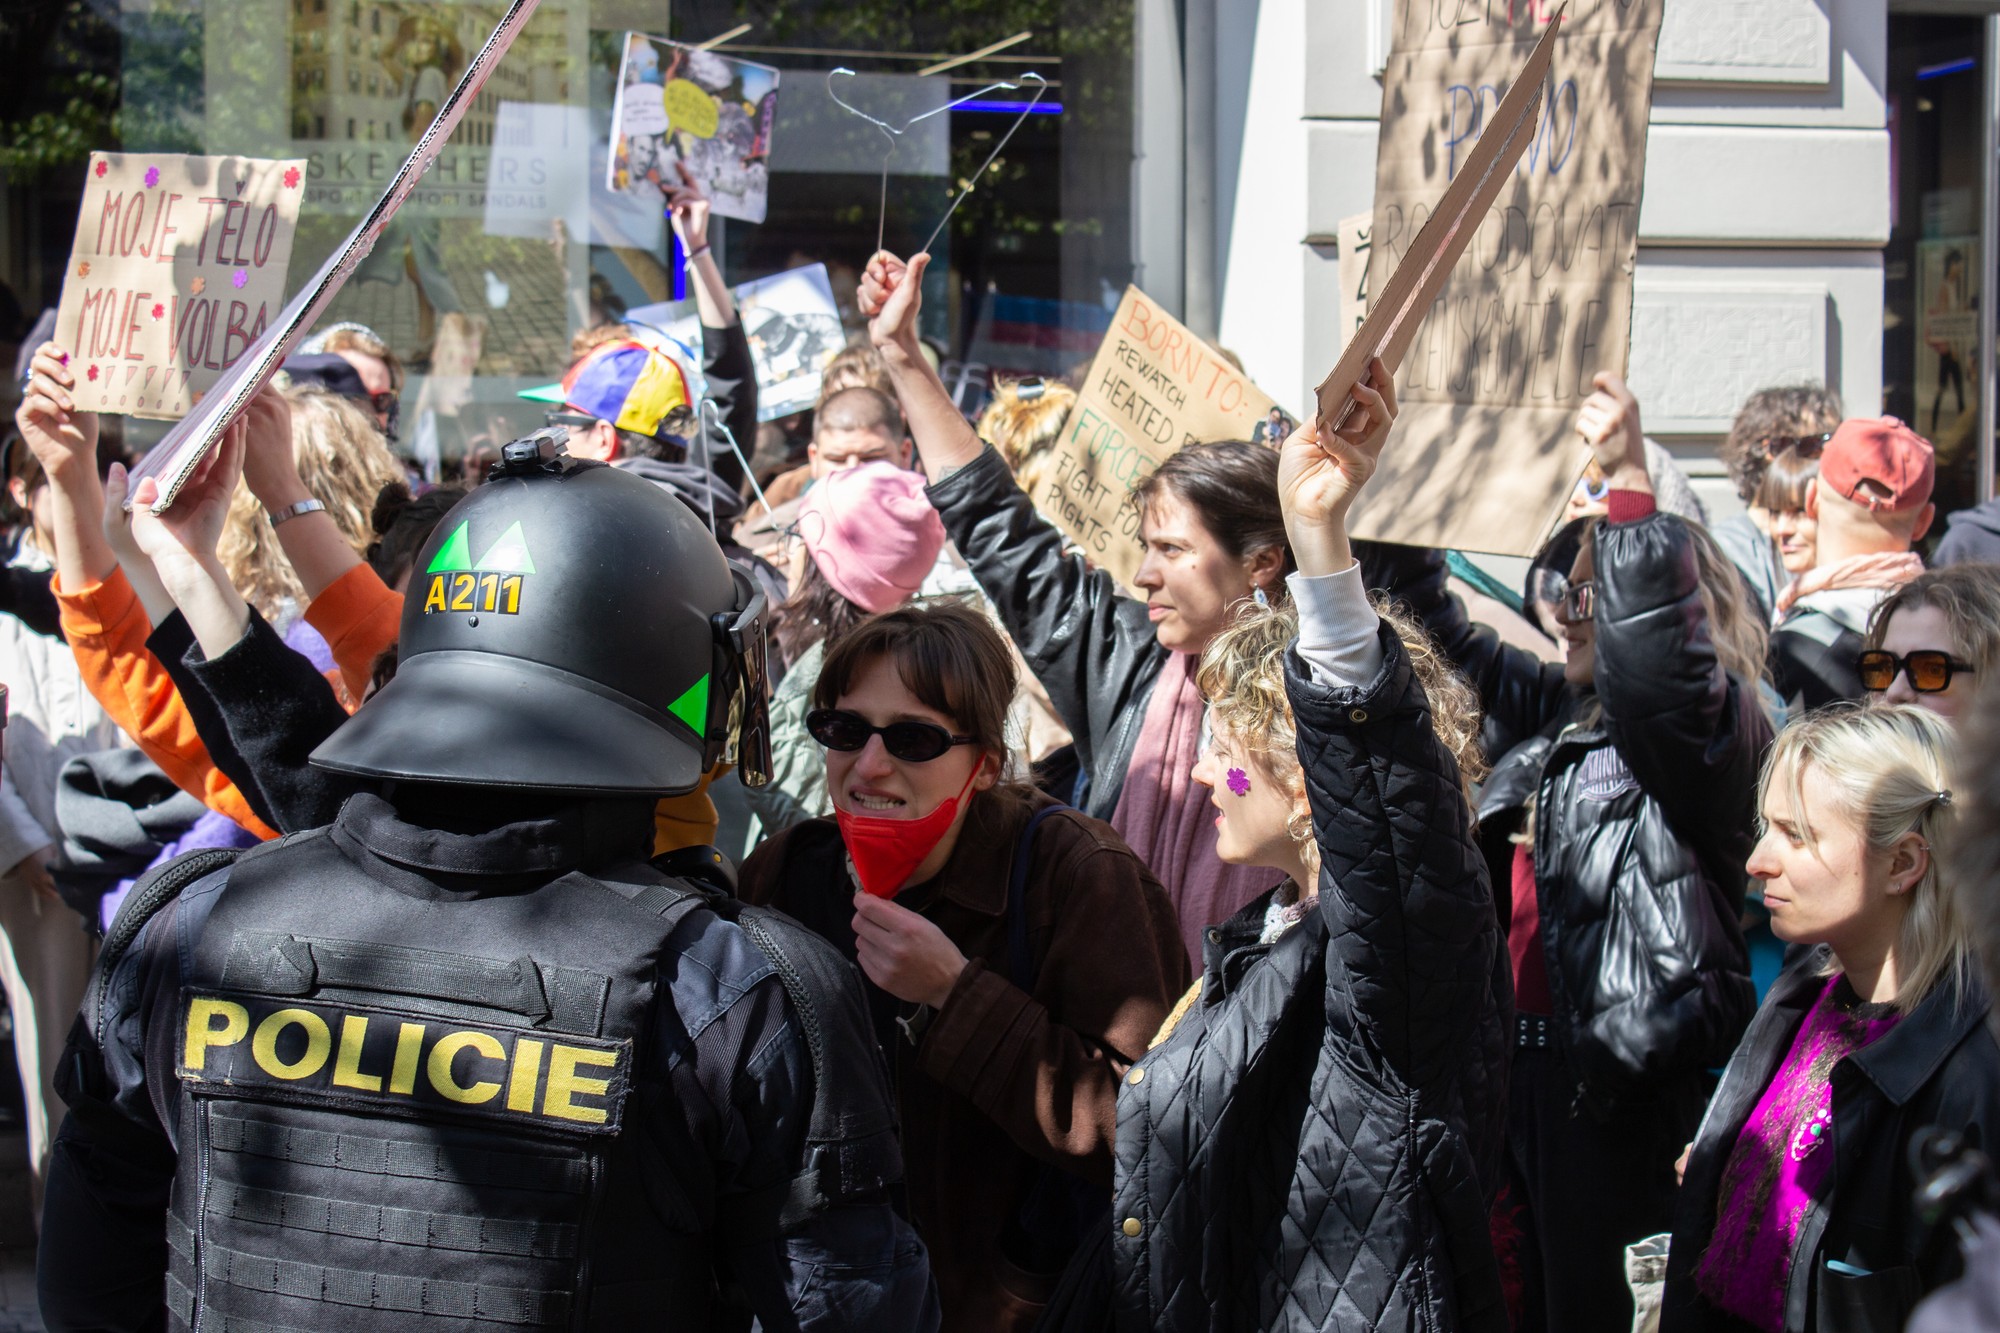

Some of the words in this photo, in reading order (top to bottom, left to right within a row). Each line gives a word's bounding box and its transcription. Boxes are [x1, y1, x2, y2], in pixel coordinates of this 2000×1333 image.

[308, 152, 547, 186] SKEHERS
[371, 190, 460, 207] CMFORT
[96, 190, 183, 264] MOJE
[197, 181, 279, 268] TĚLO
[74, 288, 152, 362] MOJE
[168, 295, 267, 372] VOLBA
[1120, 299, 1204, 384] BORN
[1204, 360, 1249, 417] TO:
[1522, 287, 1603, 401] TĚLE
[1099, 367, 1175, 445] HEATED
[1114, 339, 1188, 412] REWATCH
[1071, 407, 1155, 493] FORCE
[1046, 483, 1114, 553] RIGHTS
[1056, 450, 1113, 510] FIGHT
[1112, 502, 1141, 542] FO
[424, 573, 522, 614] A211
[183, 997, 619, 1124] POLICIE
